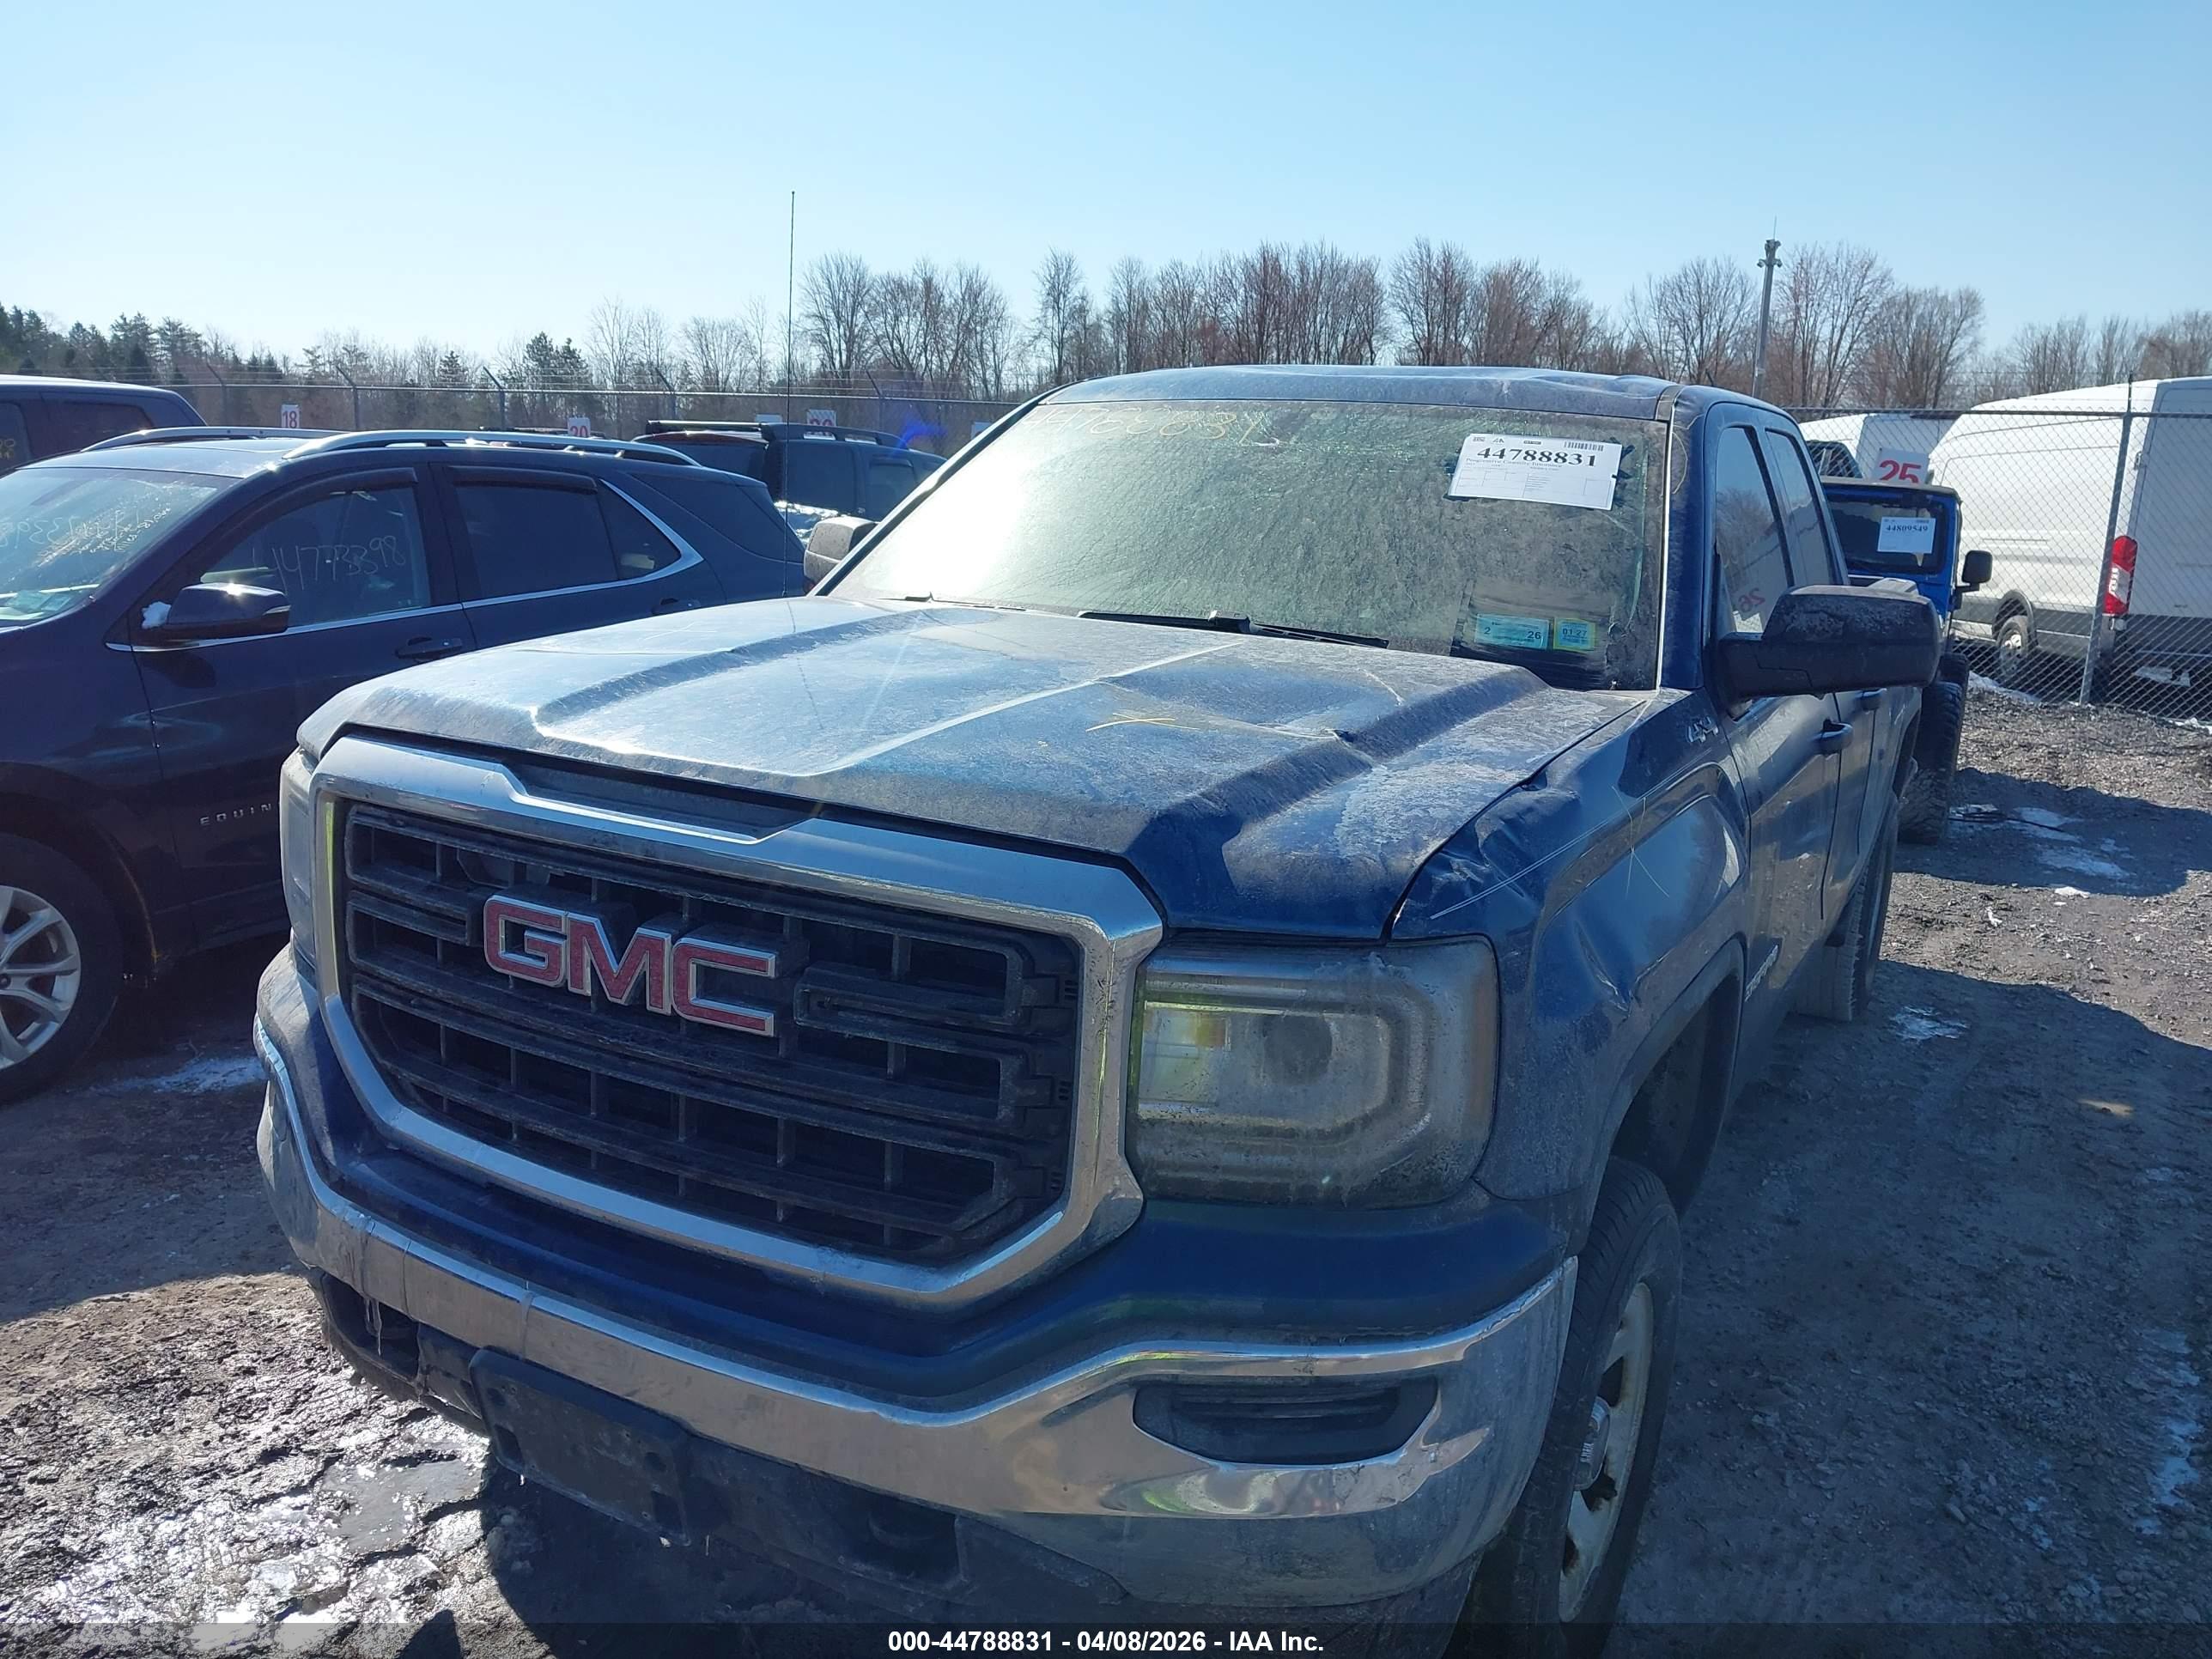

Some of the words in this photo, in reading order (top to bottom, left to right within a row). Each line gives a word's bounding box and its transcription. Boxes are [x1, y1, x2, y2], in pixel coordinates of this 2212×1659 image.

[282, 410, 298, 428] 18
[1477, 447, 1596, 467] 44788831
[1879, 459, 1922, 483] 25
[1527, 630, 1541, 639] 26
[483, 894, 775, 1037] GMC
